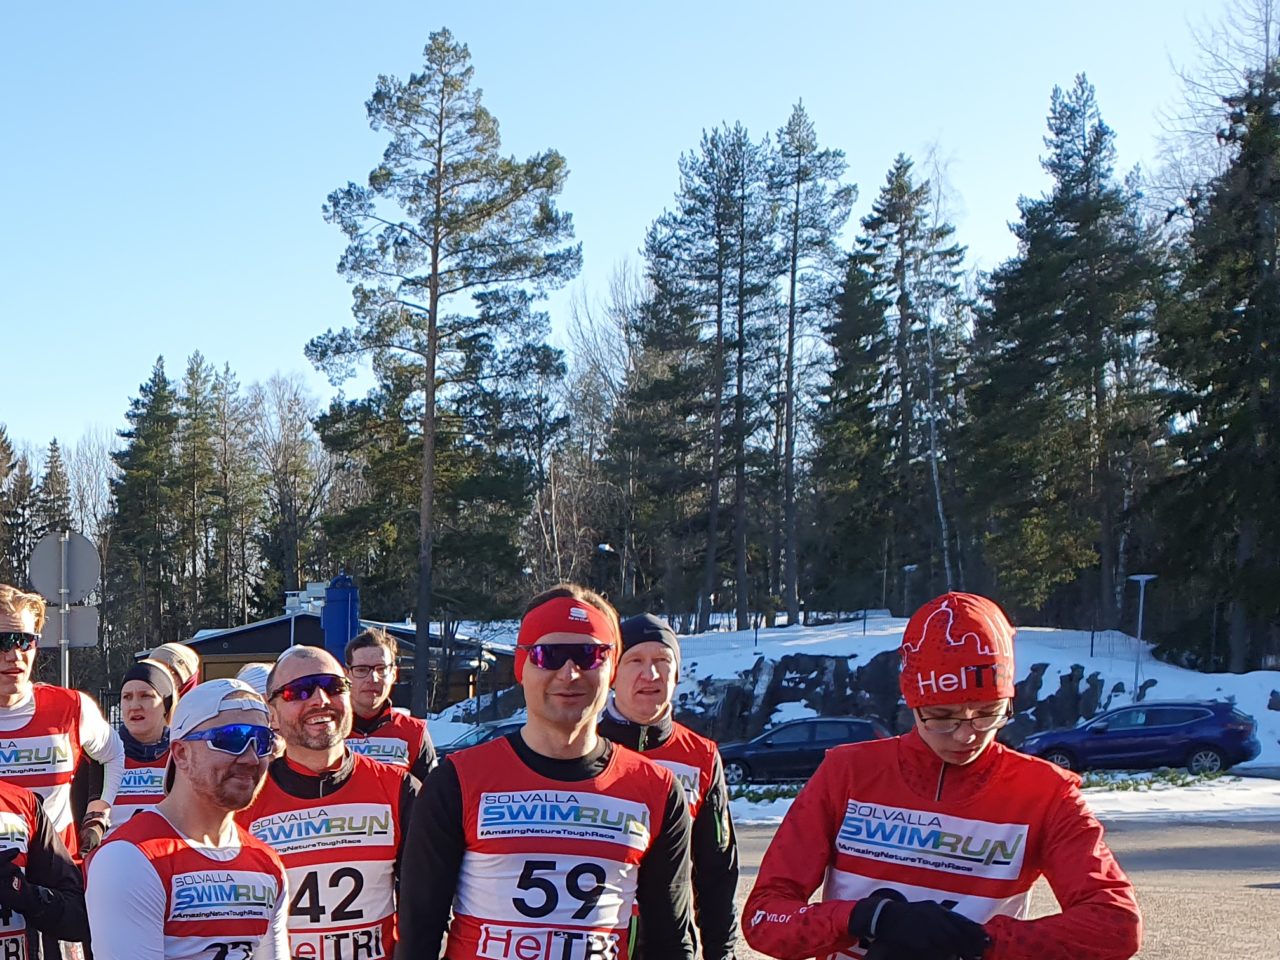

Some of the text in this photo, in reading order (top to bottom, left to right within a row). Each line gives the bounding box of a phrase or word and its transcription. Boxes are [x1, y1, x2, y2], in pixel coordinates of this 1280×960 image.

[485, 793, 580, 805] SOLVALLA
[252, 809, 329, 831] SOLVALLA
[482, 804, 647, 834] SWIMRUN
[846, 803, 942, 828] SOLVALLA
[839, 816, 1023, 866] SWIMRUN
[175, 873, 235, 888] SOLVALLA
[511, 860, 607, 920] 59
[173, 884, 277, 909] SWIMRUN
[288, 867, 364, 923] 42
